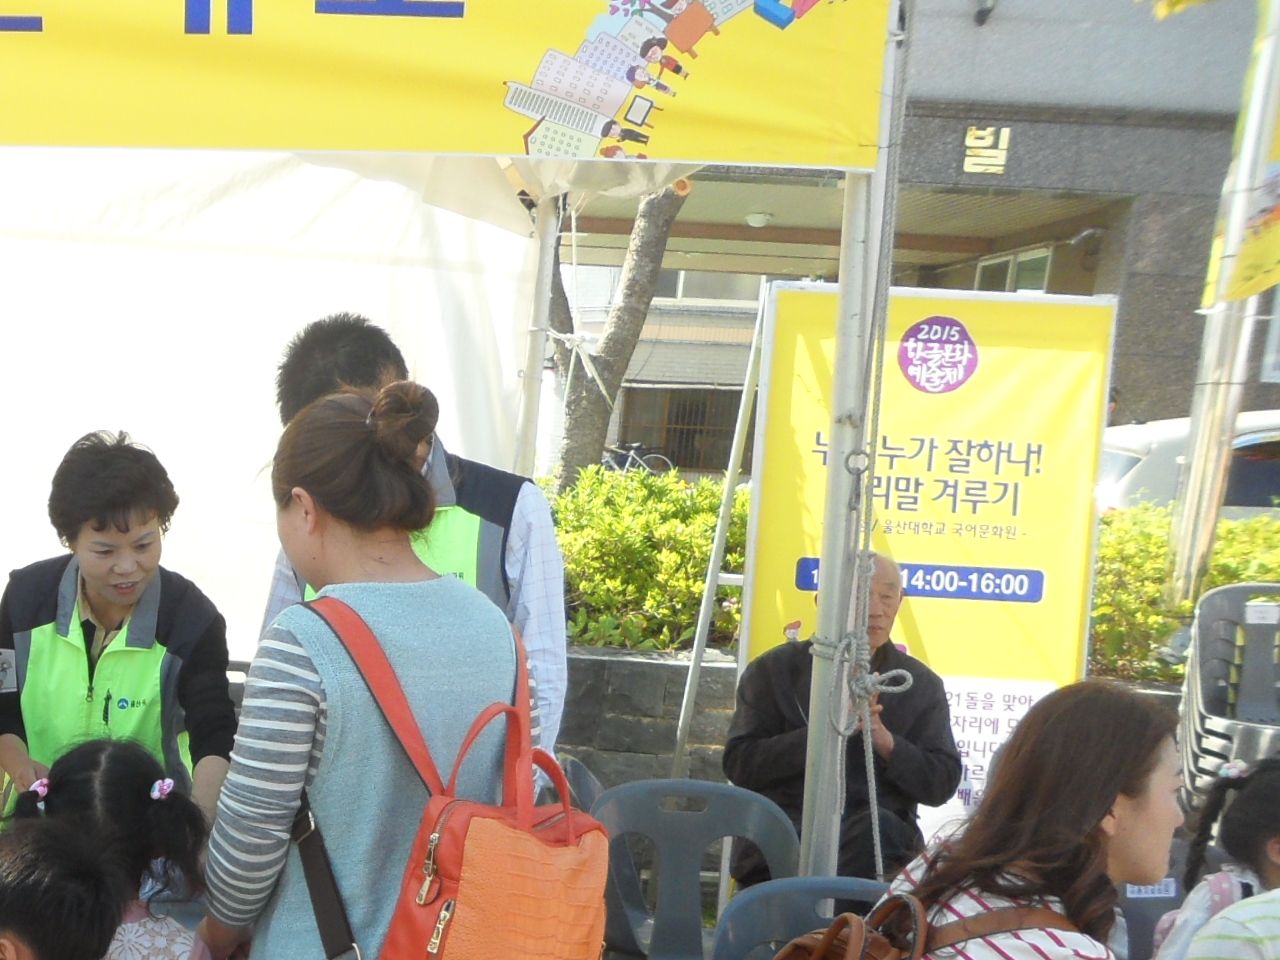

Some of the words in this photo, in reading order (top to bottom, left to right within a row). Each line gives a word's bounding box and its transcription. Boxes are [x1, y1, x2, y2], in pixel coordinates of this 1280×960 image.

[917, 325, 960, 341] 2015
[903, 337, 973, 366] 한글문화
[907, 363, 964, 392] 예술제
[945, 438, 1043, 477] 잘하나!
[871, 475, 924, 512] 리말
[931, 478, 1019, 516] 겨루기
[882, 519, 946, 536] 울산대학교
[952, 522, 1017, 540] 국어문화원
[900, 568, 1029, 595] 14:00-16:00
[950, 715, 999, 735] 자리에
